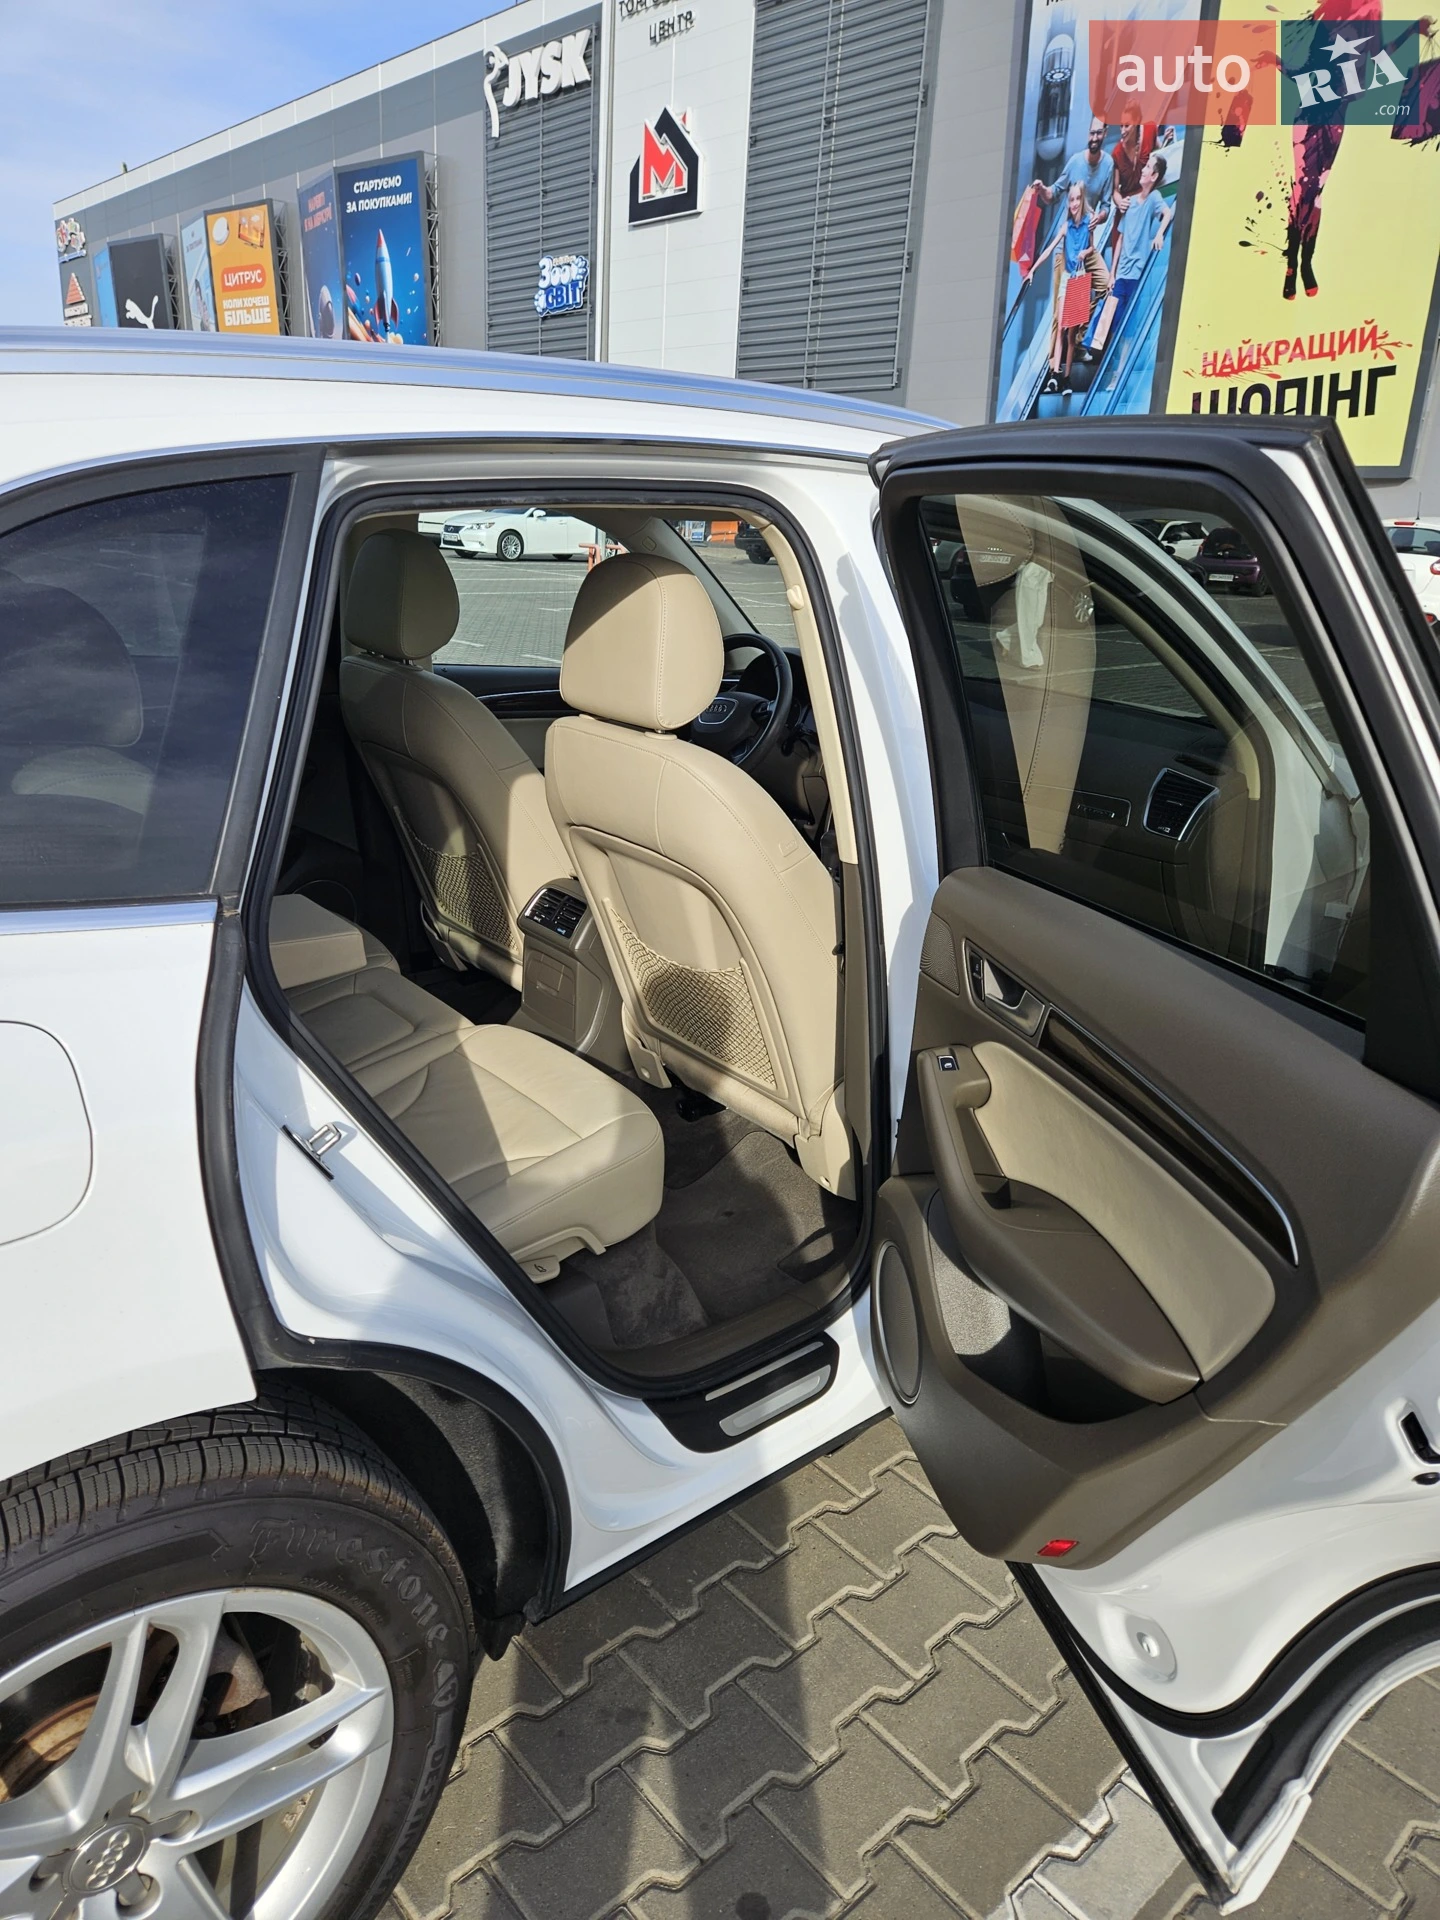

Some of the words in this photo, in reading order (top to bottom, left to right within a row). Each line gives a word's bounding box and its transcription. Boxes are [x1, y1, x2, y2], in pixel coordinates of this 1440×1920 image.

[649, 10, 693, 45] ЦЕНТР
[502, 29, 591, 107] JYSK
[353, 175, 402, 194] СТАРТУЄМО
[346, 201, 357, 213] ЗА
[359, 192, 413, 209] ПОКУПКАМИ!
[223, 268, 263, 288] ЦИТРУС
[223, 307, 272, 327] БІЛЬШЕ
[1201, 318, 1379, 377] НАЙКРАЩИЙ
